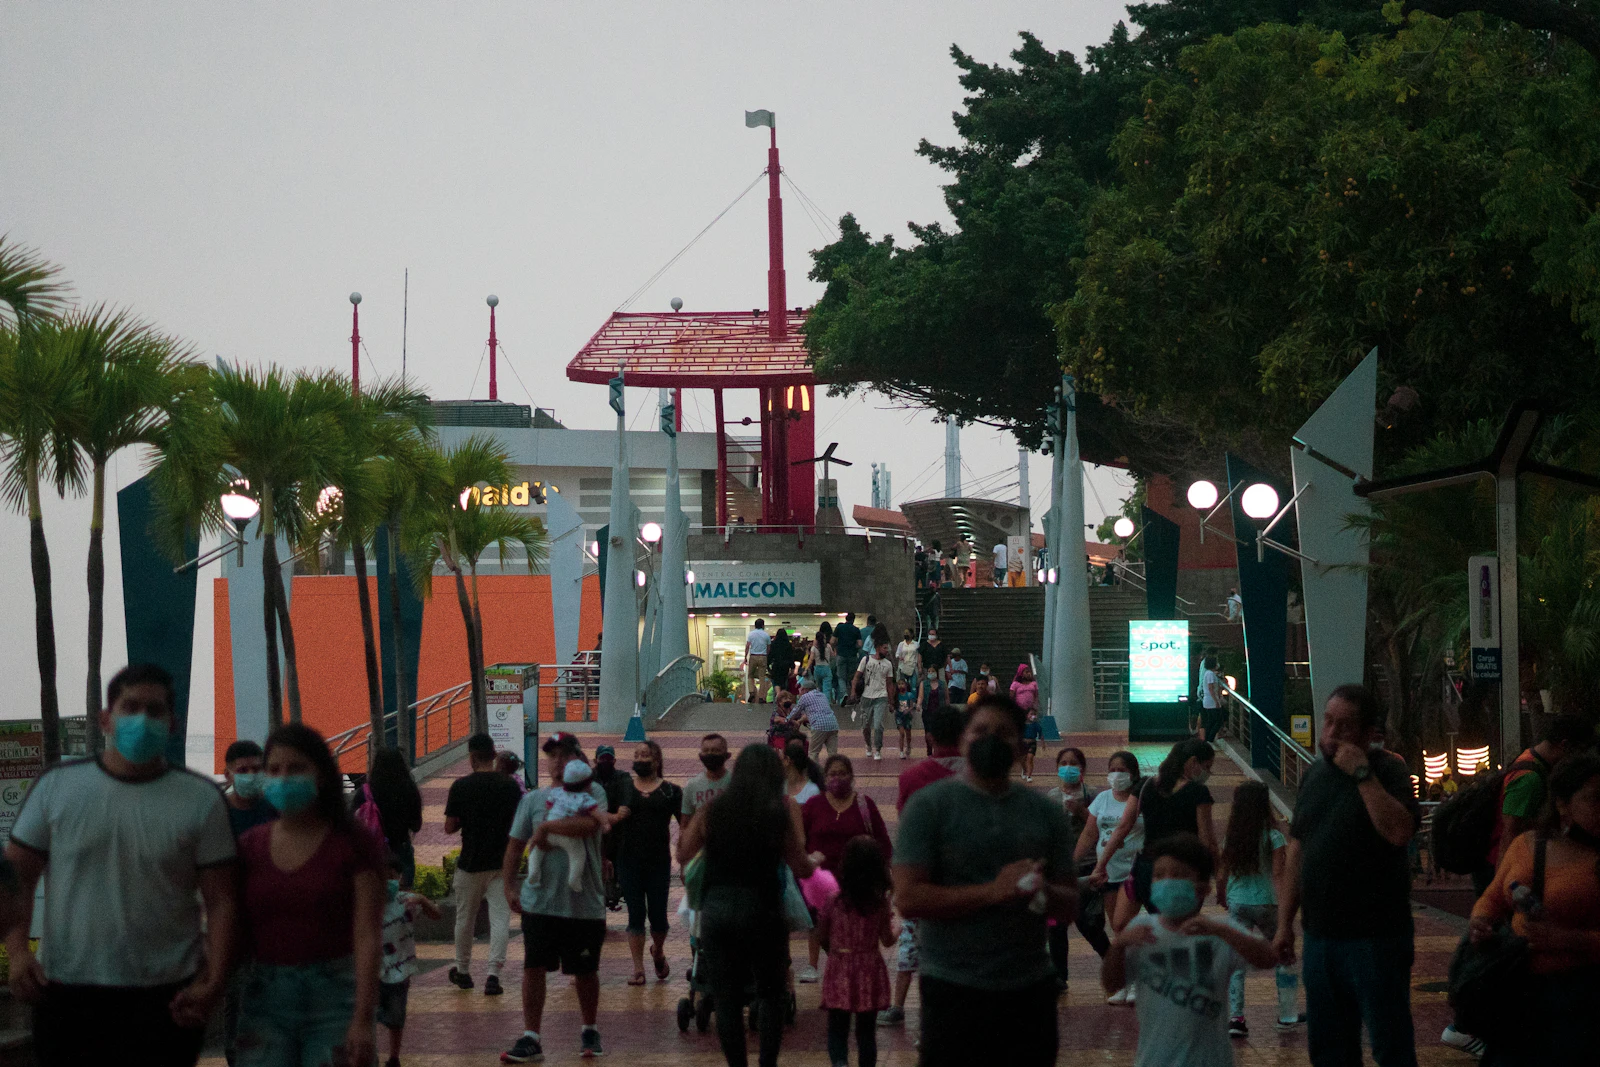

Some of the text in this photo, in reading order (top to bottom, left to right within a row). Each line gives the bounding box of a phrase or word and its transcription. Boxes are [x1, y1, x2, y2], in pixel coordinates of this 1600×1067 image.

[471, 482, 559, 506] nald'
[695, 578, 795, 598] MALECÓN
[1140, 641, 1180, 651] spot.
[1133, 655, 1186, 668] 50%
